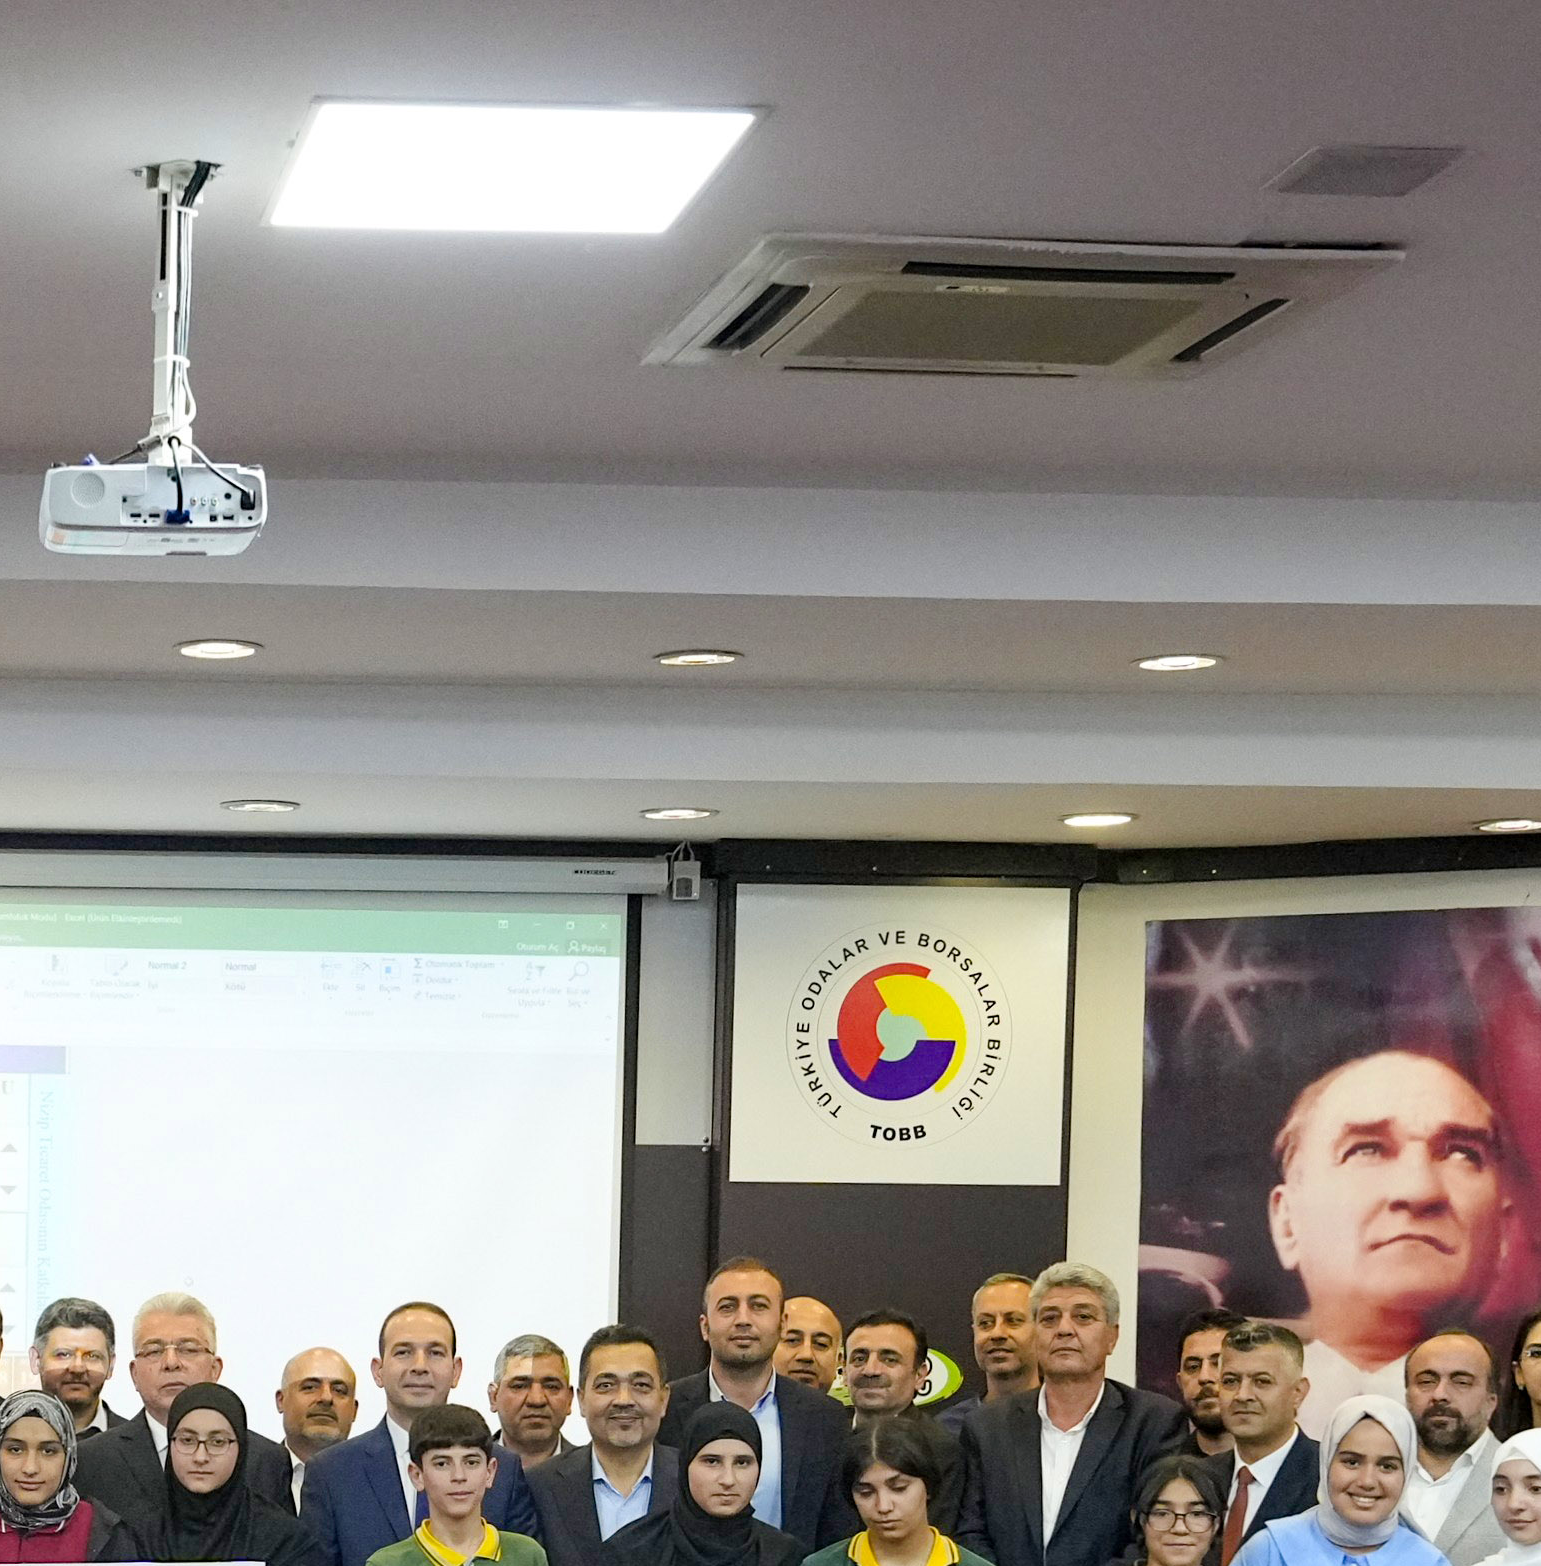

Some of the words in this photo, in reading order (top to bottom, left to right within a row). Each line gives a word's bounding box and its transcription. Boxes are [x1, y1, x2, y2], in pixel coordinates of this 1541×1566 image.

[801, 938, 870, 1010] ODALAR
[878, 931, 906, 945] VE
[917, 933, 1001, 1027] BORSALAR
[795, 1022, 842, 1119] TÜRKİYE
[952, 1038, 1001, 1120] BİRLİĞİ
[870, 1125, 927, 1141] TOBB
